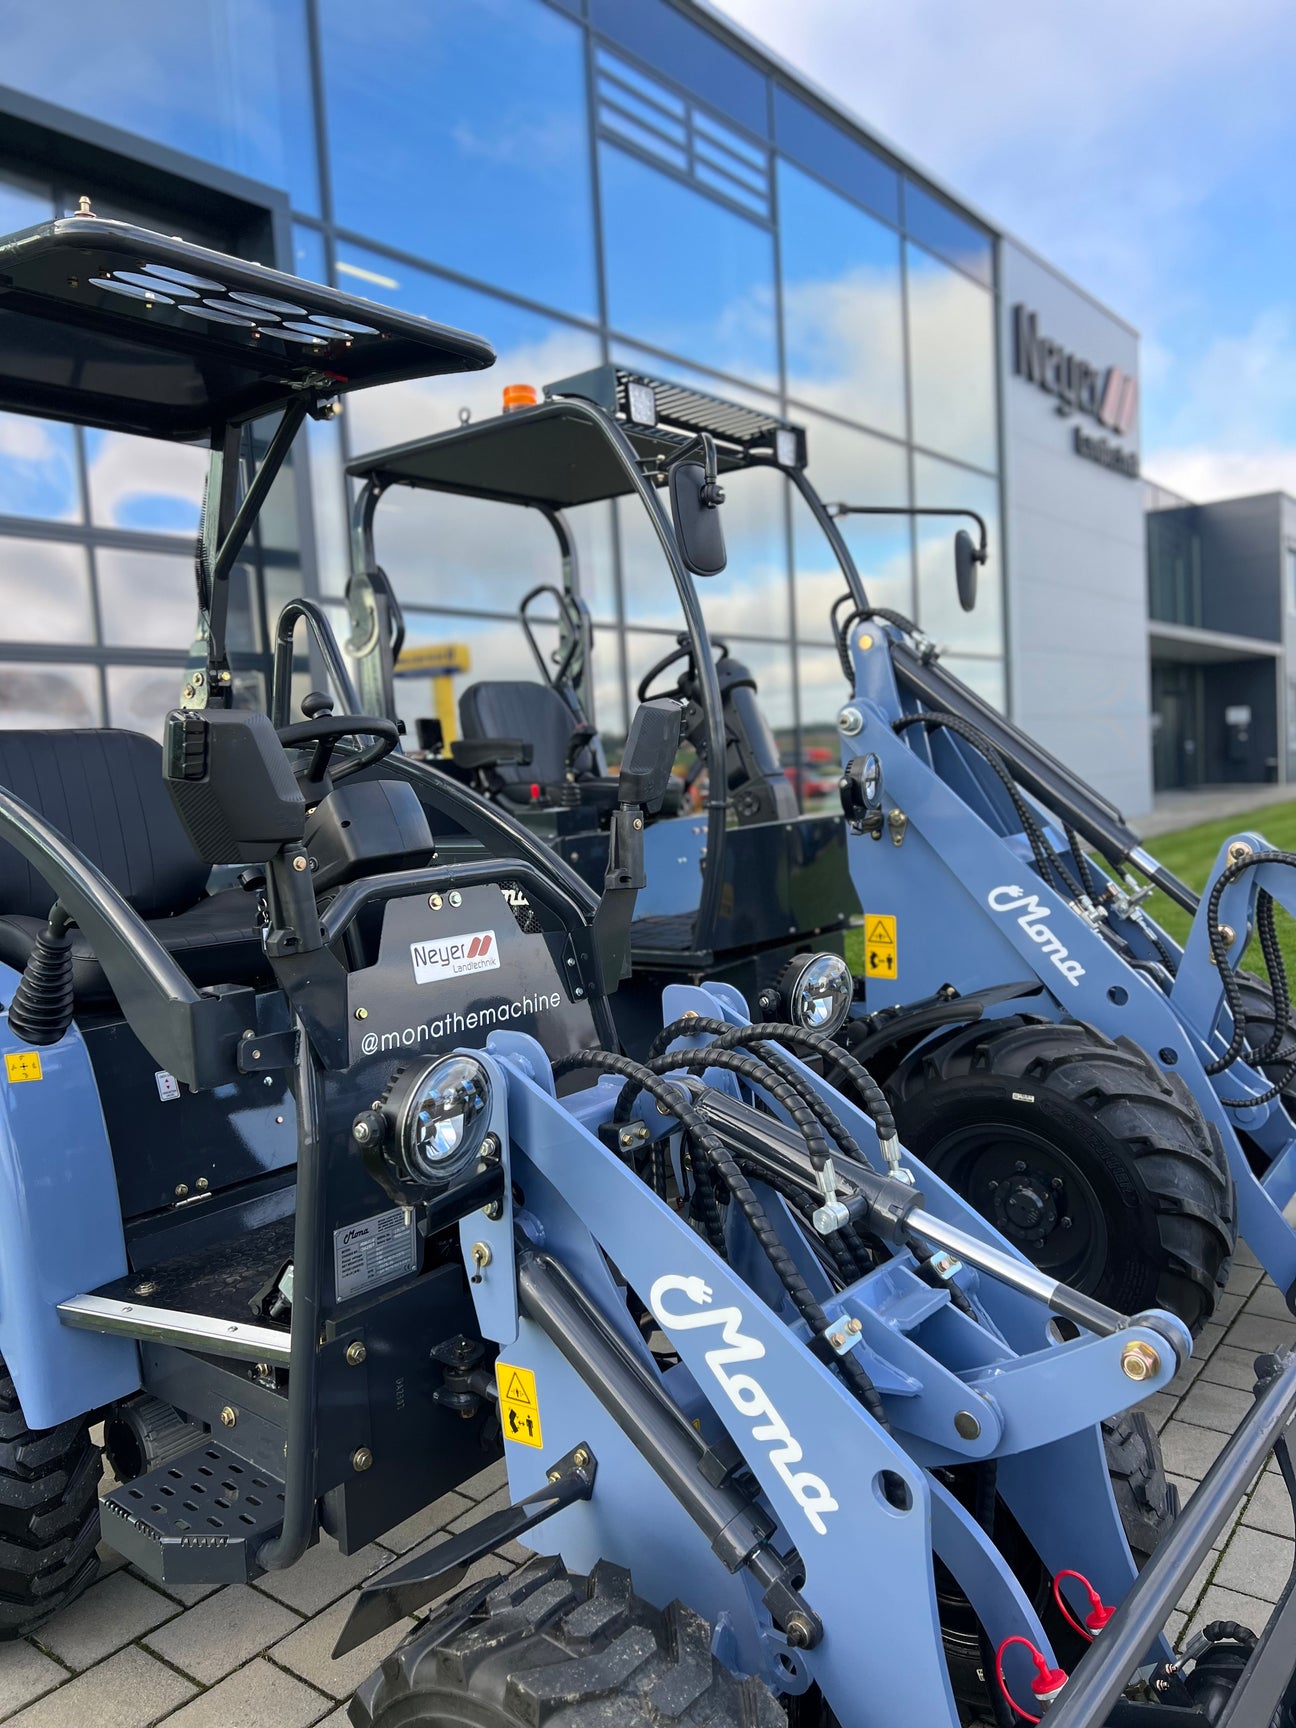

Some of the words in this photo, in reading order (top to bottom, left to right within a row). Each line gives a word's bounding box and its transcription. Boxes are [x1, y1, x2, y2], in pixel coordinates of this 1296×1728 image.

[414, 944, 465, 968] Neyer
[453, 958, 497, 973] Landtechnik
[988, 885, 1086, 987] Mona
[361, 992, 561, 1056] @monathemachine
[650, 1274, 839, 1535] Mona
